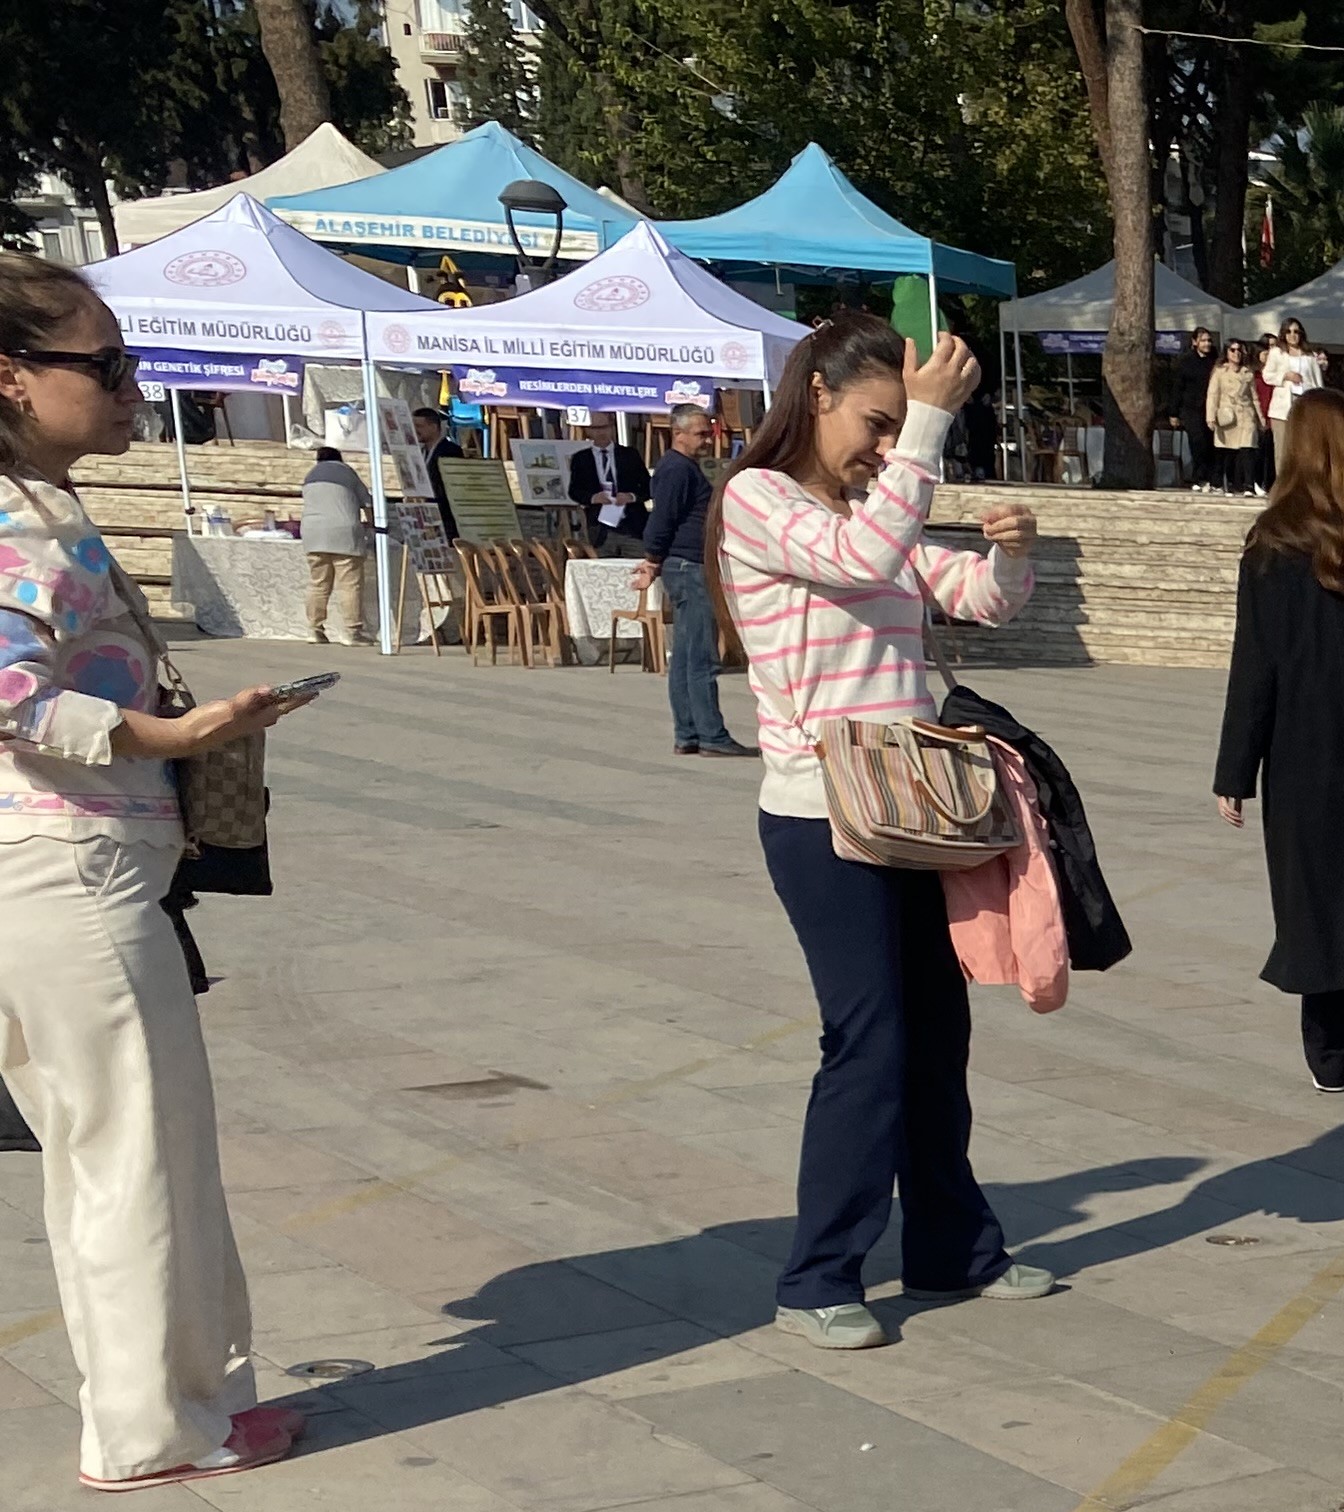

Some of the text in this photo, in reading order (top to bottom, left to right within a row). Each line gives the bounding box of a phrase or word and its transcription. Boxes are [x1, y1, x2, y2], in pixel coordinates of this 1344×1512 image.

[314, 218, 416, 238] ALAŞEHİR
[138, 316, 197, 337] EĞİTİM
[201, 322, 312, 343] MÜDÜRLÜĞÜ
[417, 334, 715, 364] MANİSA İL MİLLİ EĞİTİM MÜDÜRLÜĞÜ
[153, 360, 201, 374] GENETİK
[203, 363, 245, 377] ŞİFRESİ
[141, 383, 164, 400] 38
[569, 408, 588, 423] 37
